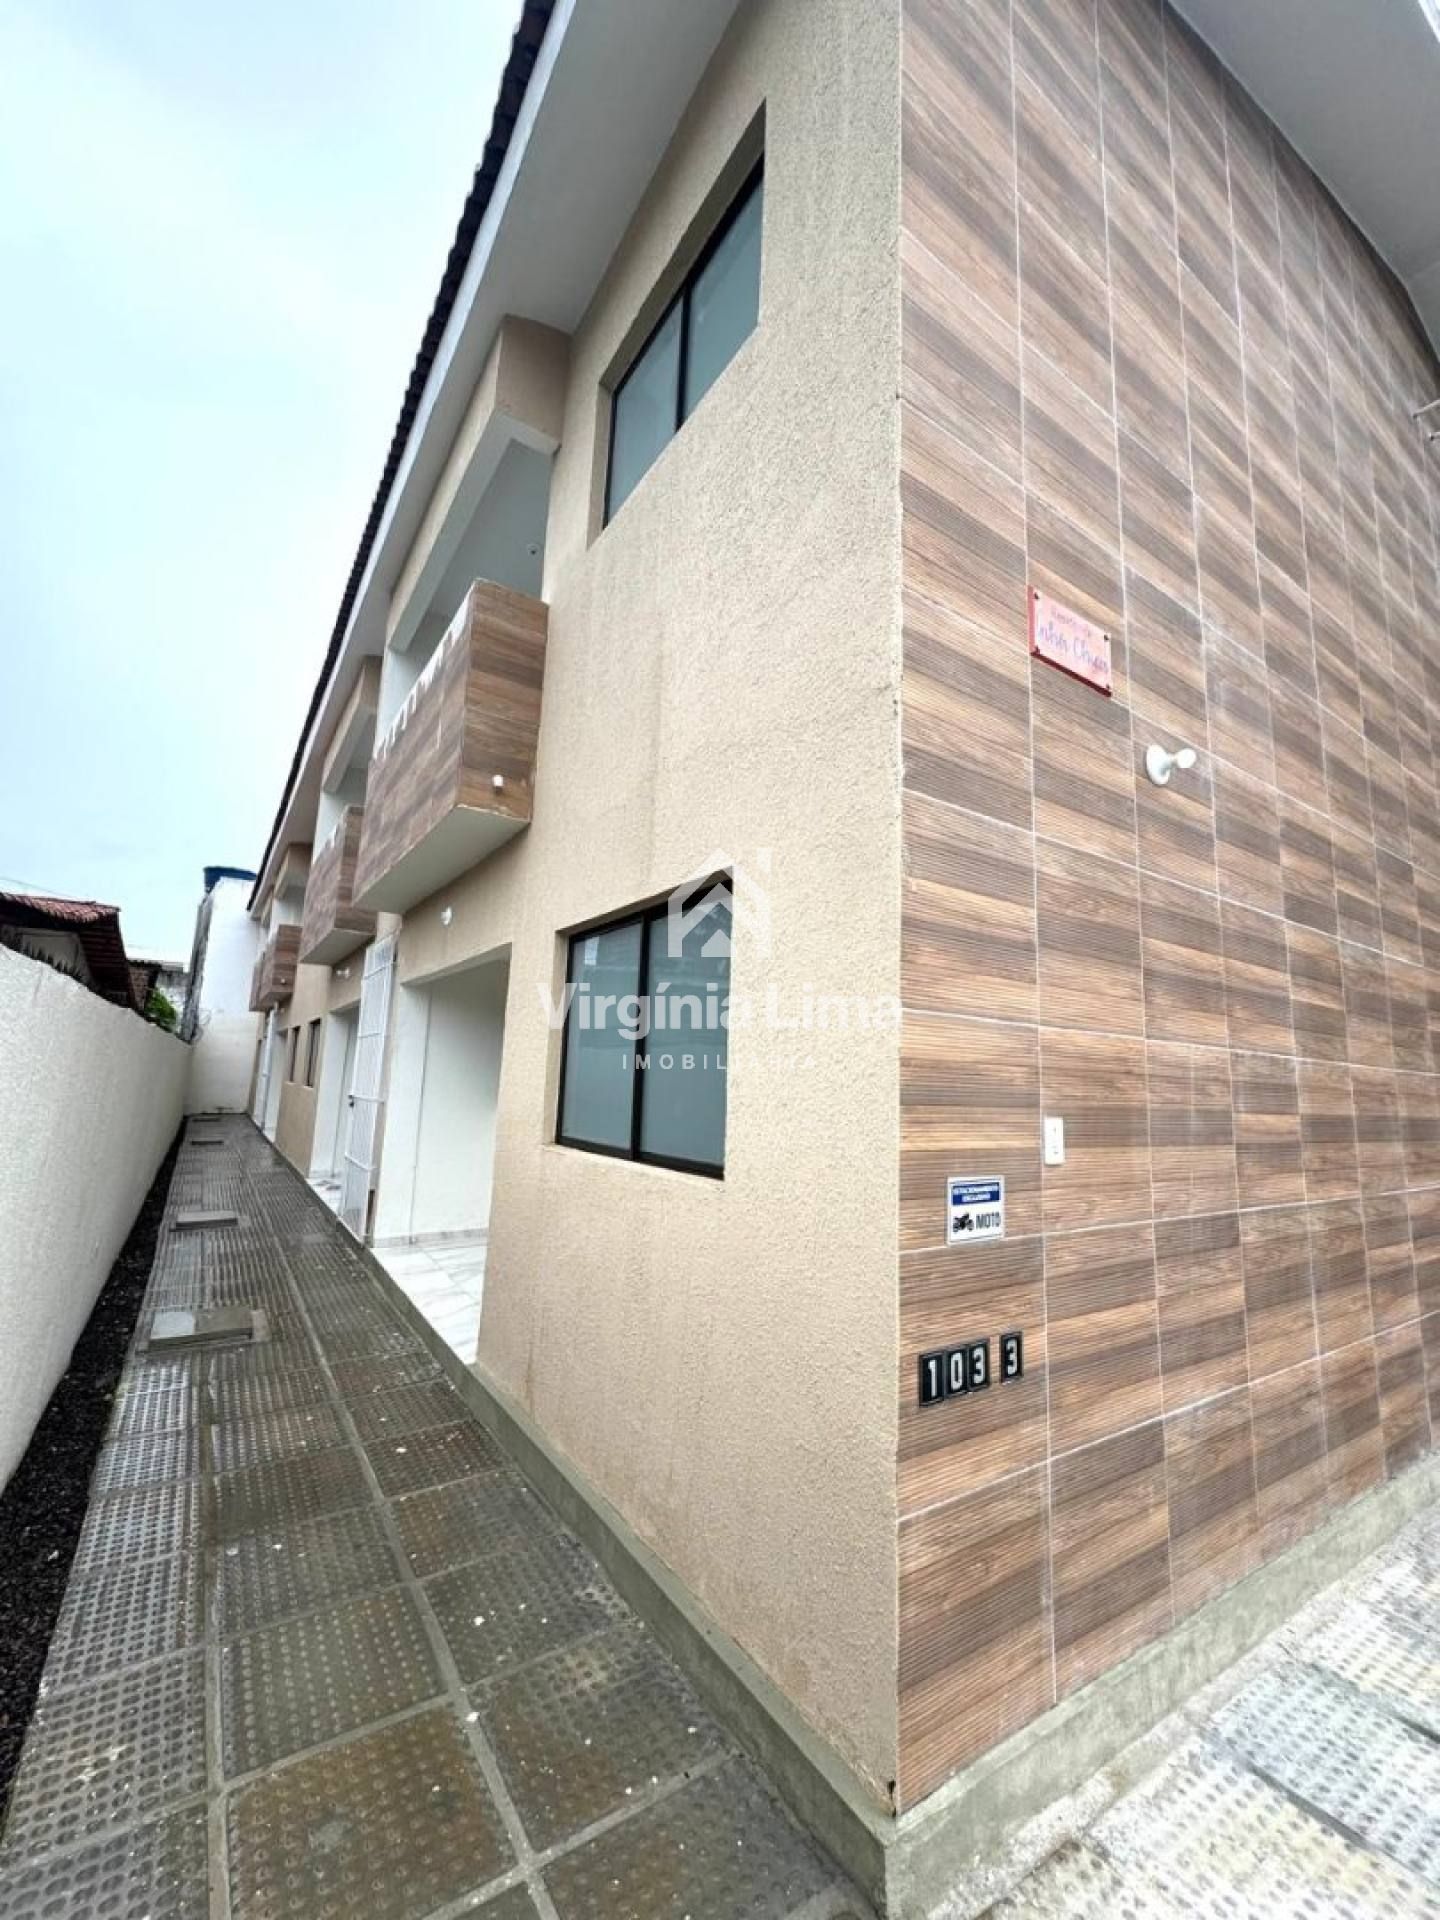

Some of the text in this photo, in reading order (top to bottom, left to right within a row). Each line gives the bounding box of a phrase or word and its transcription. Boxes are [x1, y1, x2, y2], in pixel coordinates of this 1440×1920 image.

[975, 1212, 1000, 1229] MOTO
[928, 1339, 1018, 1398] 103 3
